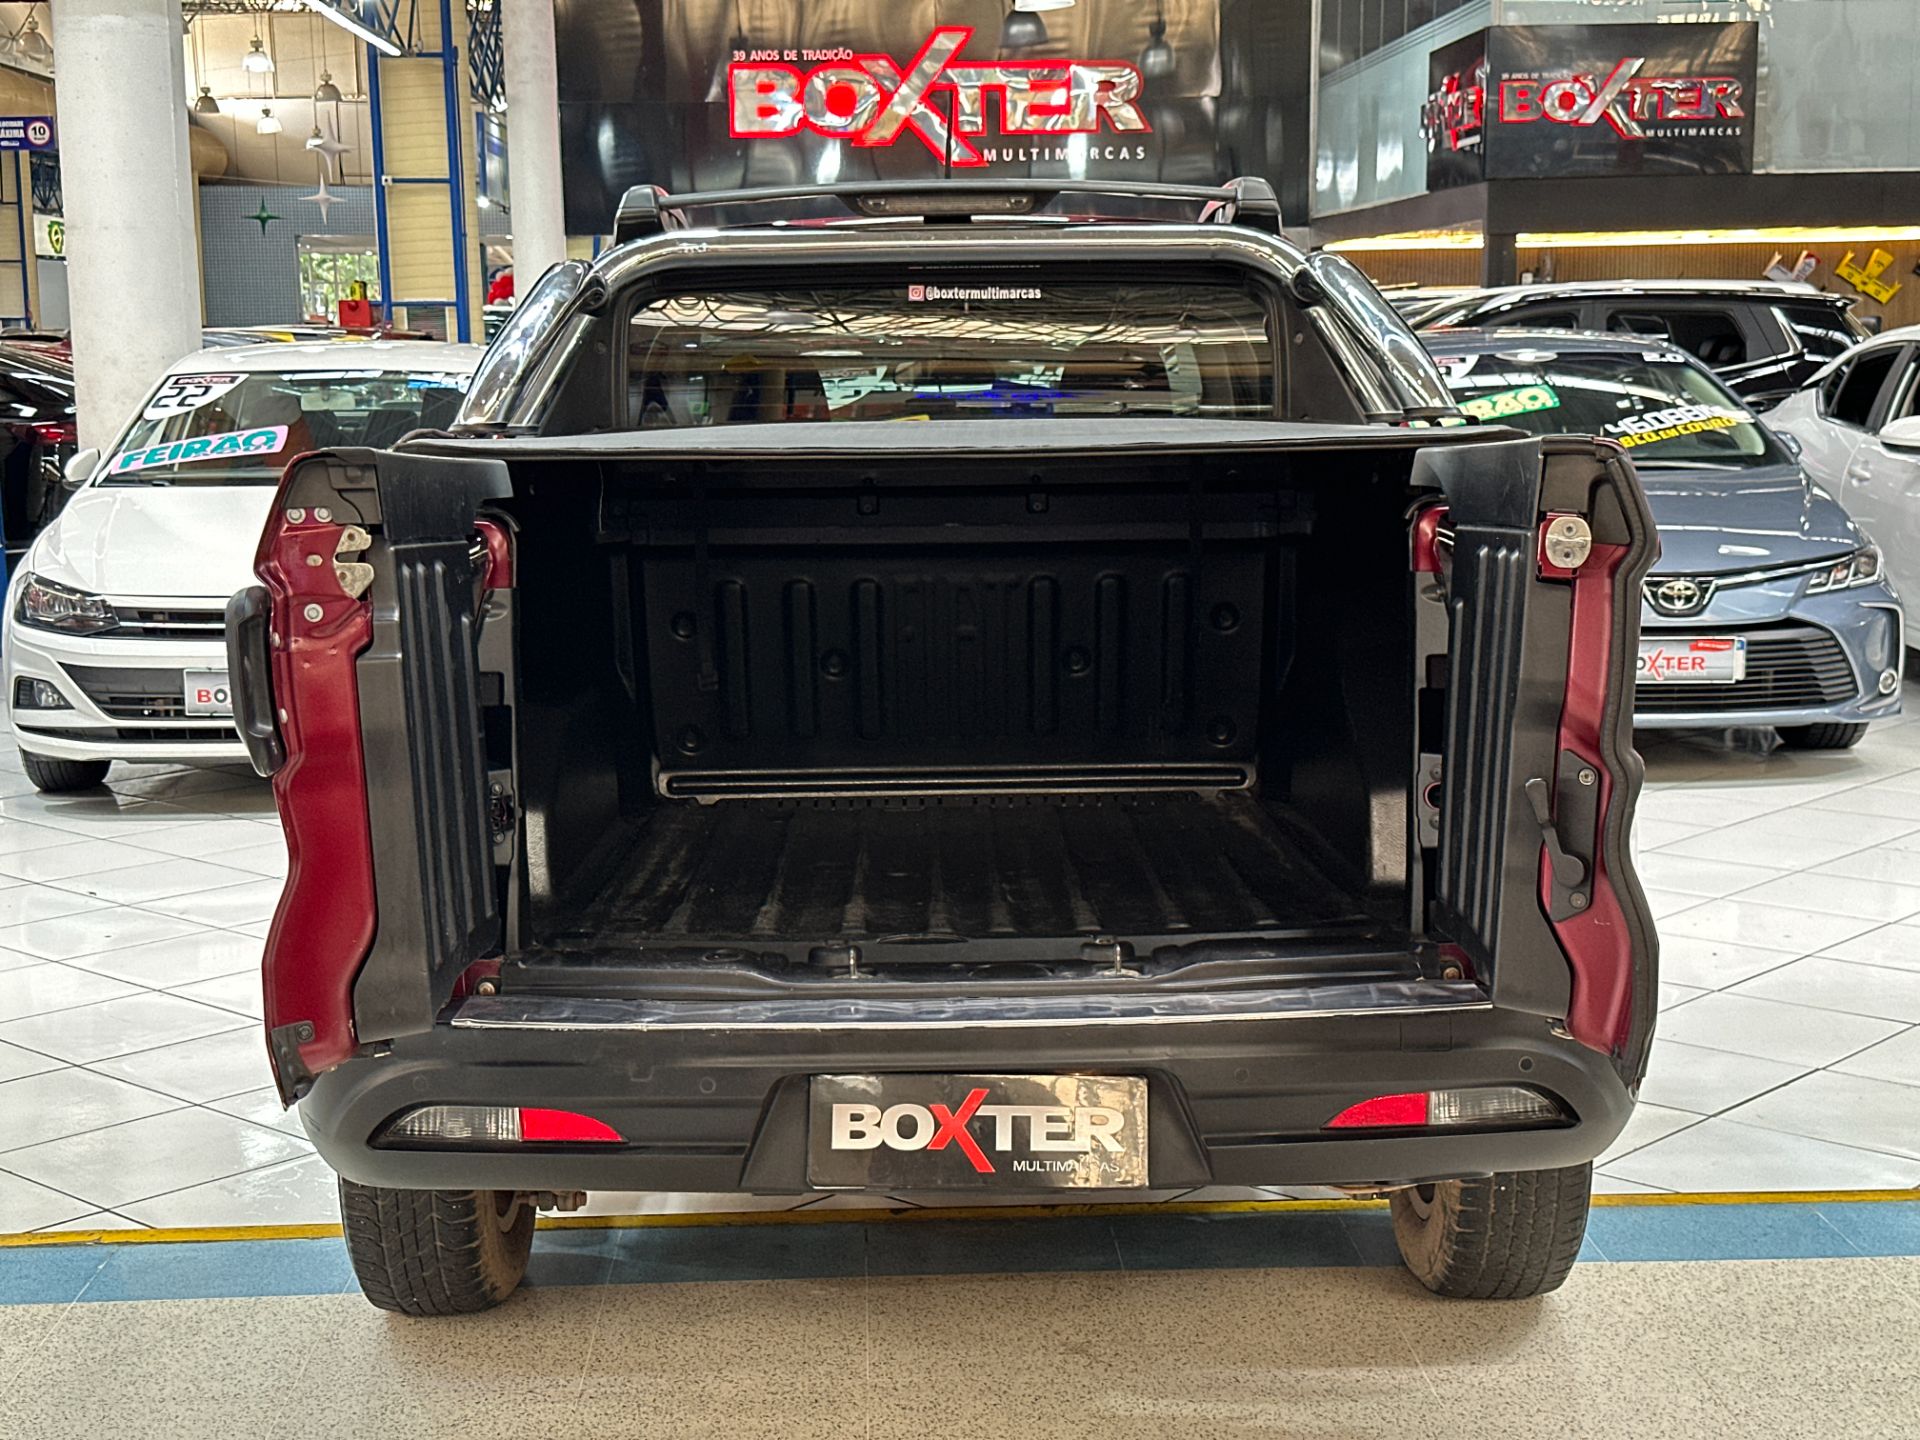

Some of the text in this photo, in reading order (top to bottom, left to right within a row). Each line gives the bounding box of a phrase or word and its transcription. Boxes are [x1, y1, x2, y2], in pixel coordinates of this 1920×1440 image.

[733, 47, 853, 62] 39 ANOS DE TRADIÇÃO
[728, 25, 1153, 166] BOXTER
[1499, 57, 1744, 140] BOXTER
[31, 126, 46, 136] 10
[1645, 127, 1741, 138] MULTIMARCAS
[983, 146, 1145, 162] MULTIMRCAS
[926, 286, 1041, 300] @boxtermultimarcas
[1642, 351, 1685, 363] 2.0
[151, 385, 213, 408] 22
[1676, 416, 1737, 435] COURO
[1637, 648, 1705, 680] OXTER
[831, 1088, 1126, 1173] BOXTER
[1013, 1159, 1120, 1173] MULTIMAAS
